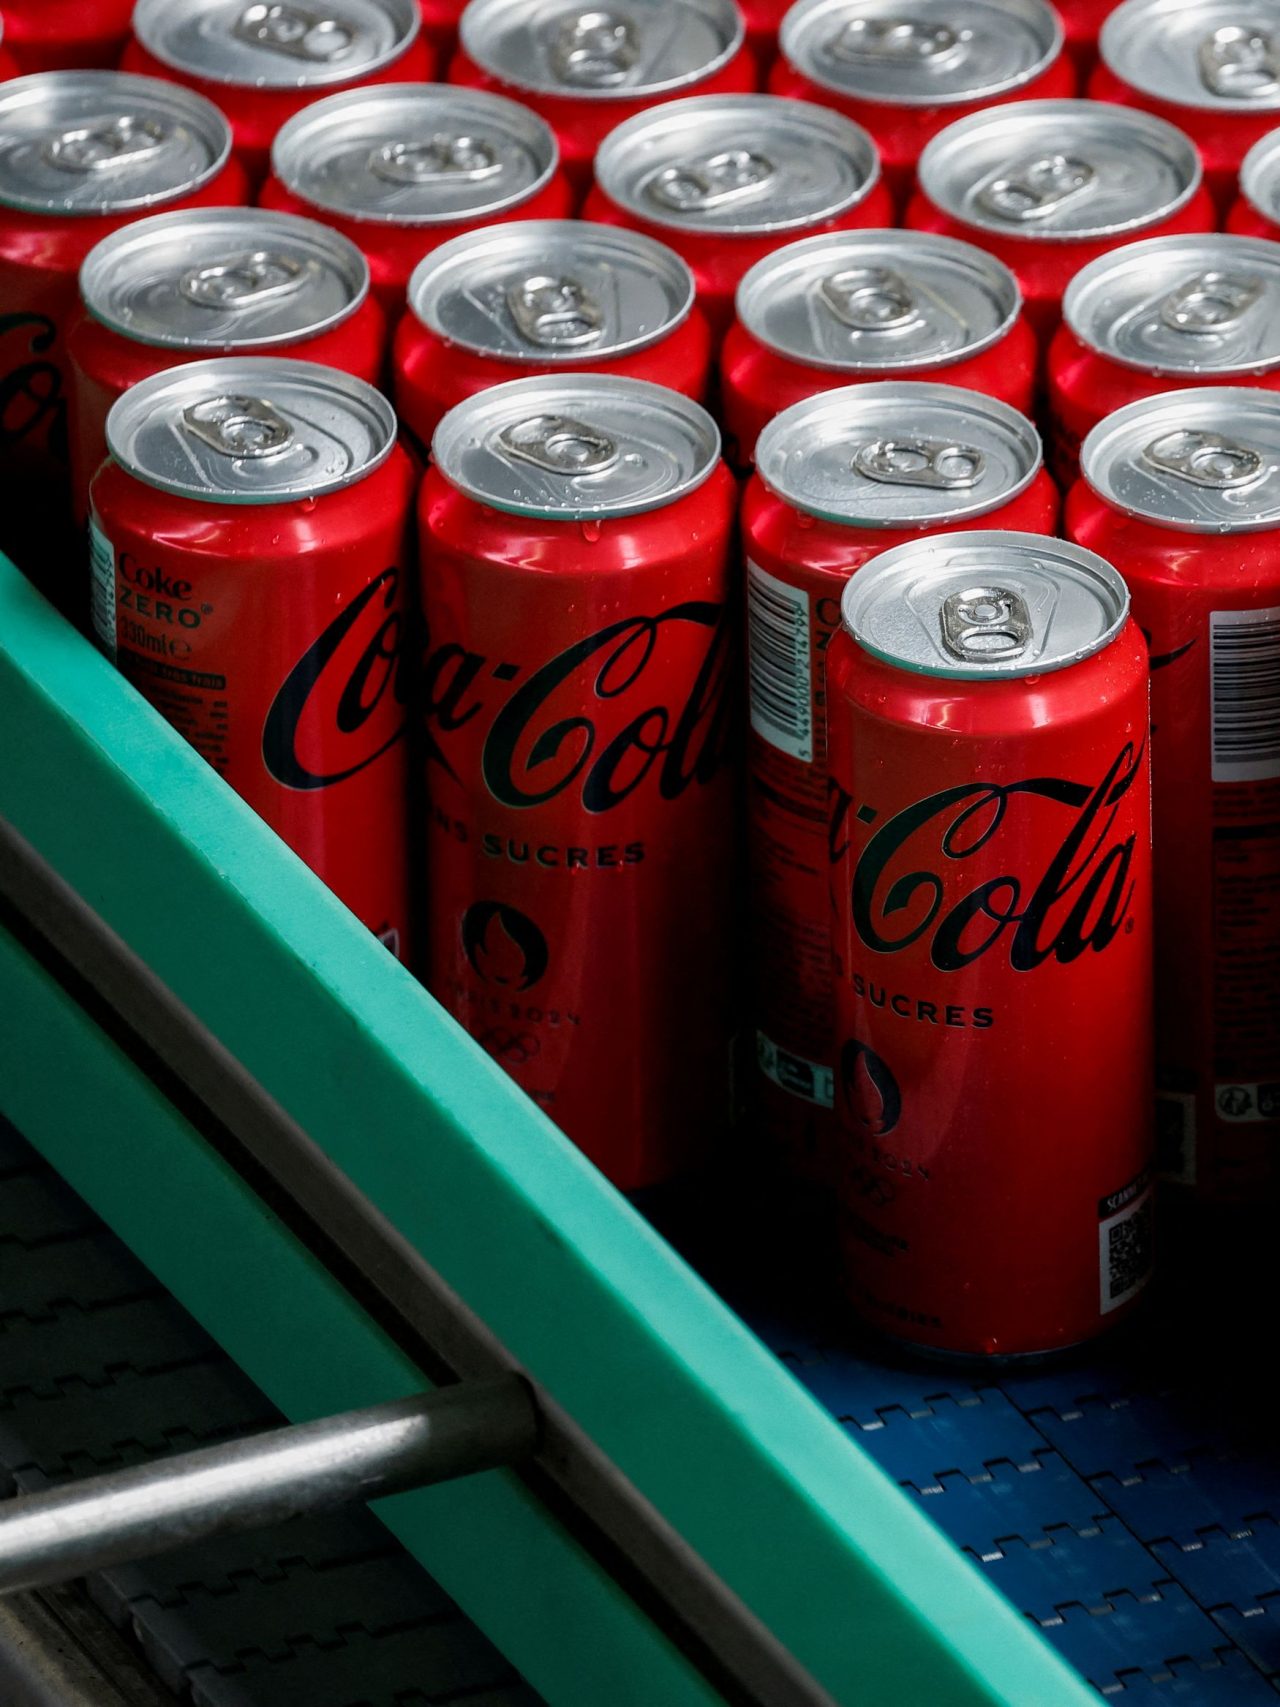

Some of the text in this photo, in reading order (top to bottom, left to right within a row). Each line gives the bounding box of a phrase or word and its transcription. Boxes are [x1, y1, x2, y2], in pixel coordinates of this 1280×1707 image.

[118, 552, 193, 600] Coke
[482, 833, 647, 869] SUCRES
[852, 974, 996, 1030] SUCRES
